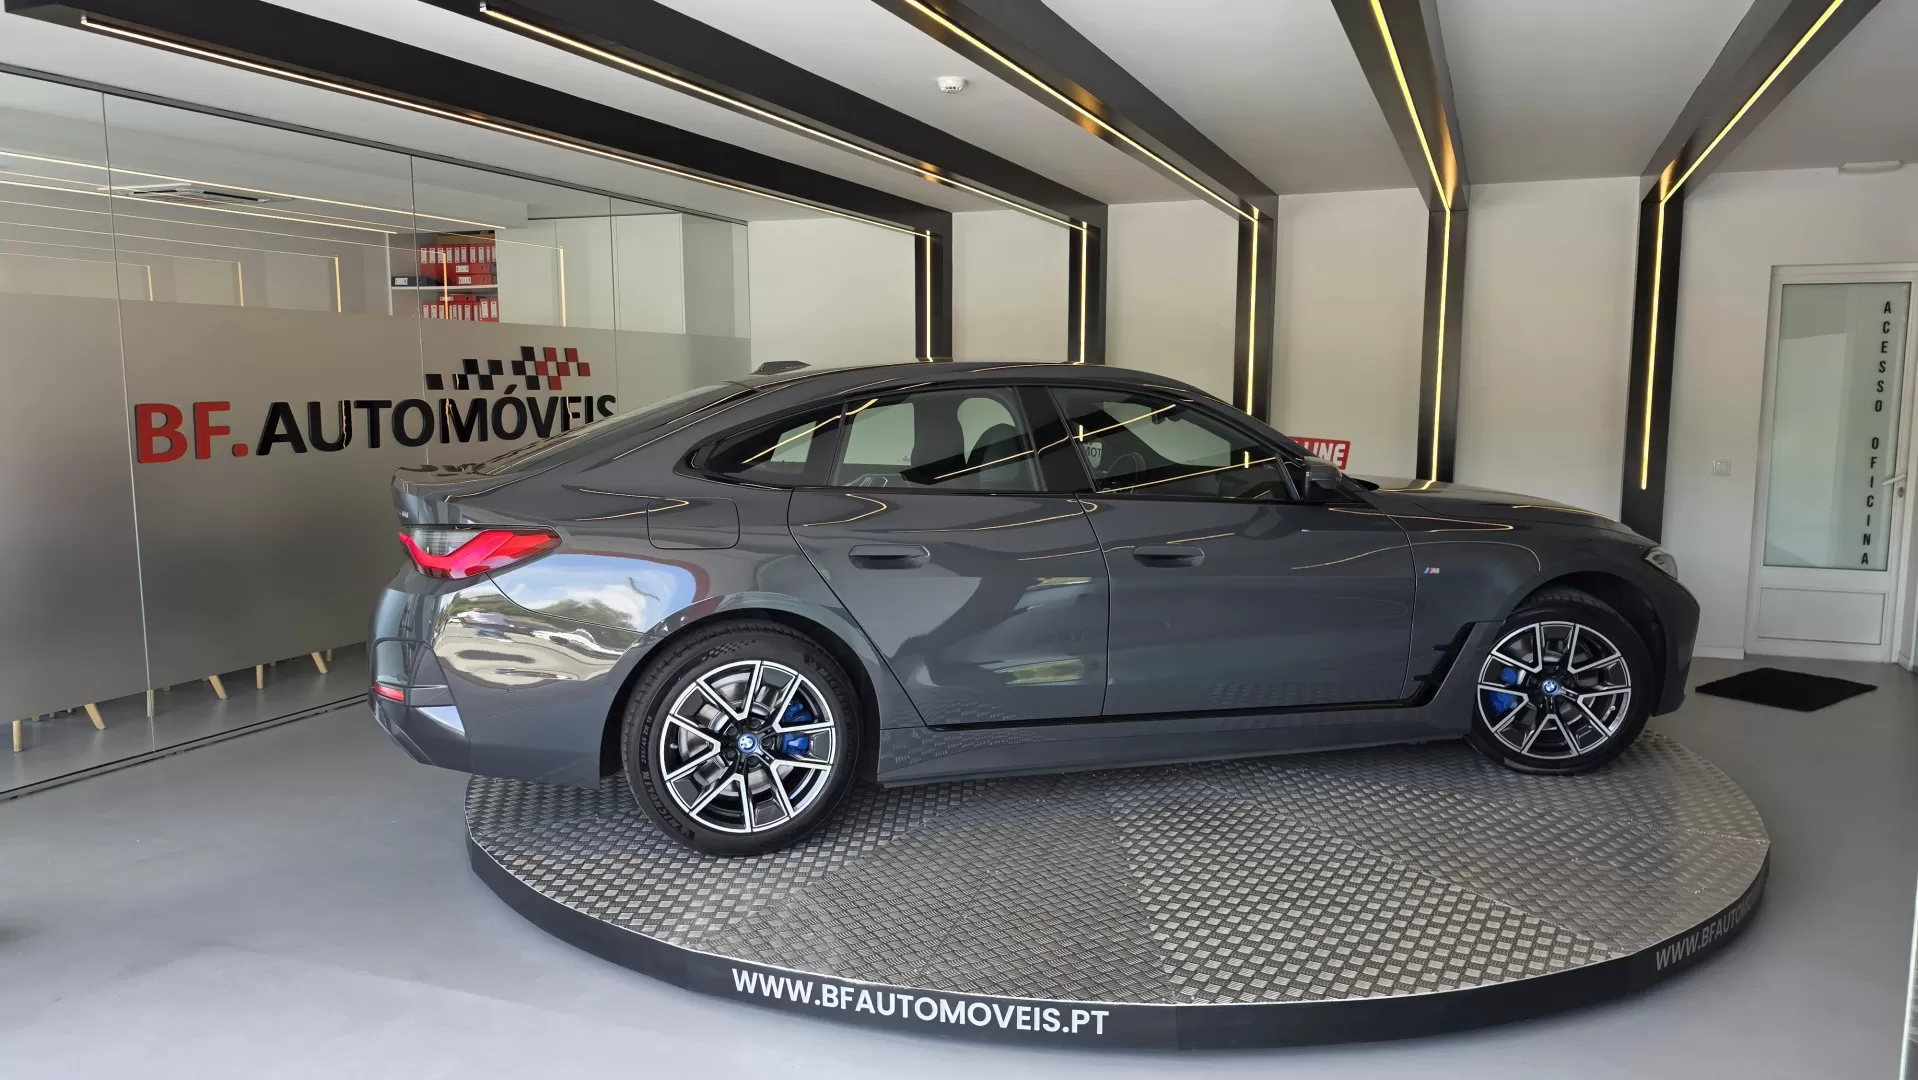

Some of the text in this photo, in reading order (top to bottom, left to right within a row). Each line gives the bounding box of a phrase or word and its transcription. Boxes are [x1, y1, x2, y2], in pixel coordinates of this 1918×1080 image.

[1860, 301, 1892, 565] ACESSO OFICINA
[731, 968, 1110, 1035] WWW.BFAUTOMOVEIS.PT
